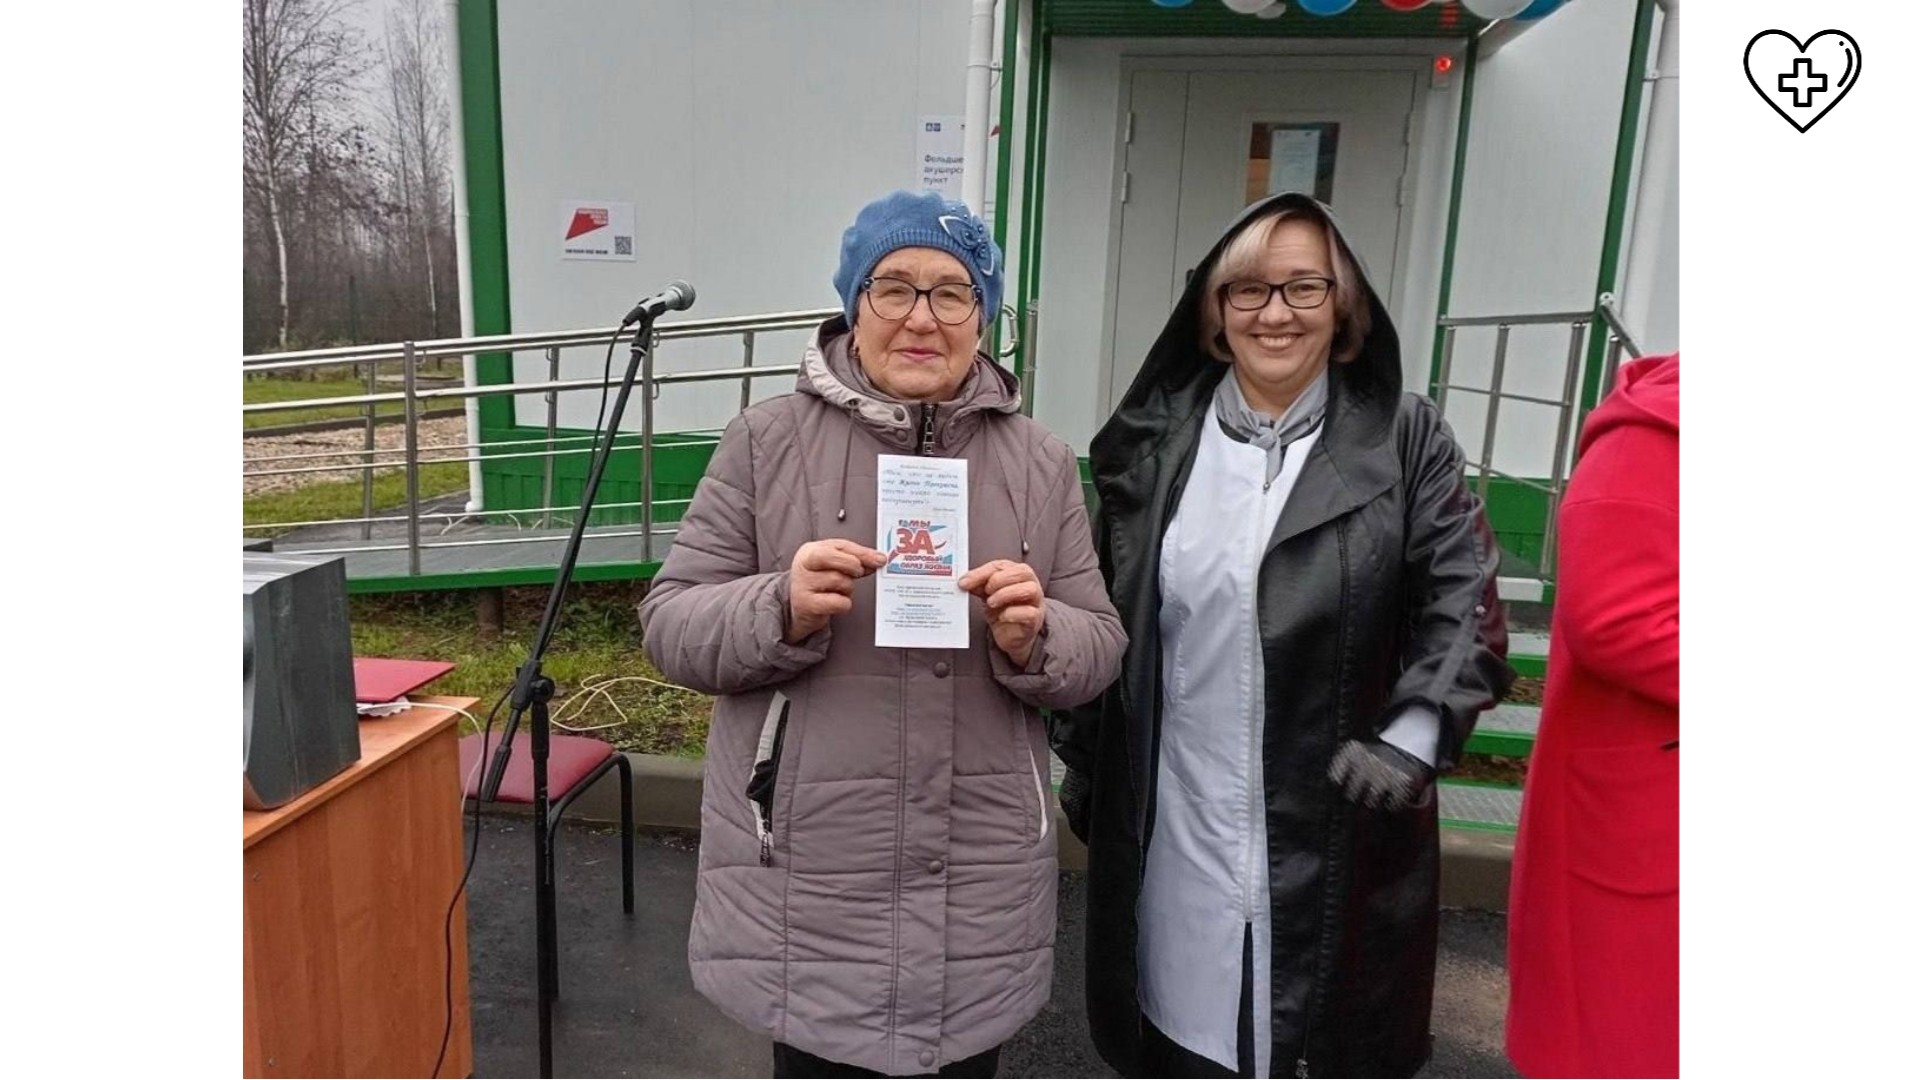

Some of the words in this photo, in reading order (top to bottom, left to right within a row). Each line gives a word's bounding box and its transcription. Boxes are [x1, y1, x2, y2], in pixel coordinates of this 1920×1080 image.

[925, 154, 964, 163] Фельдше
[924, 167, 964, 175] акушерс
[923, 177, 948, 185] пункт
[896, 527, 936, 555] ЗА
[900, 561, 924, 570] ОБРАЗ
